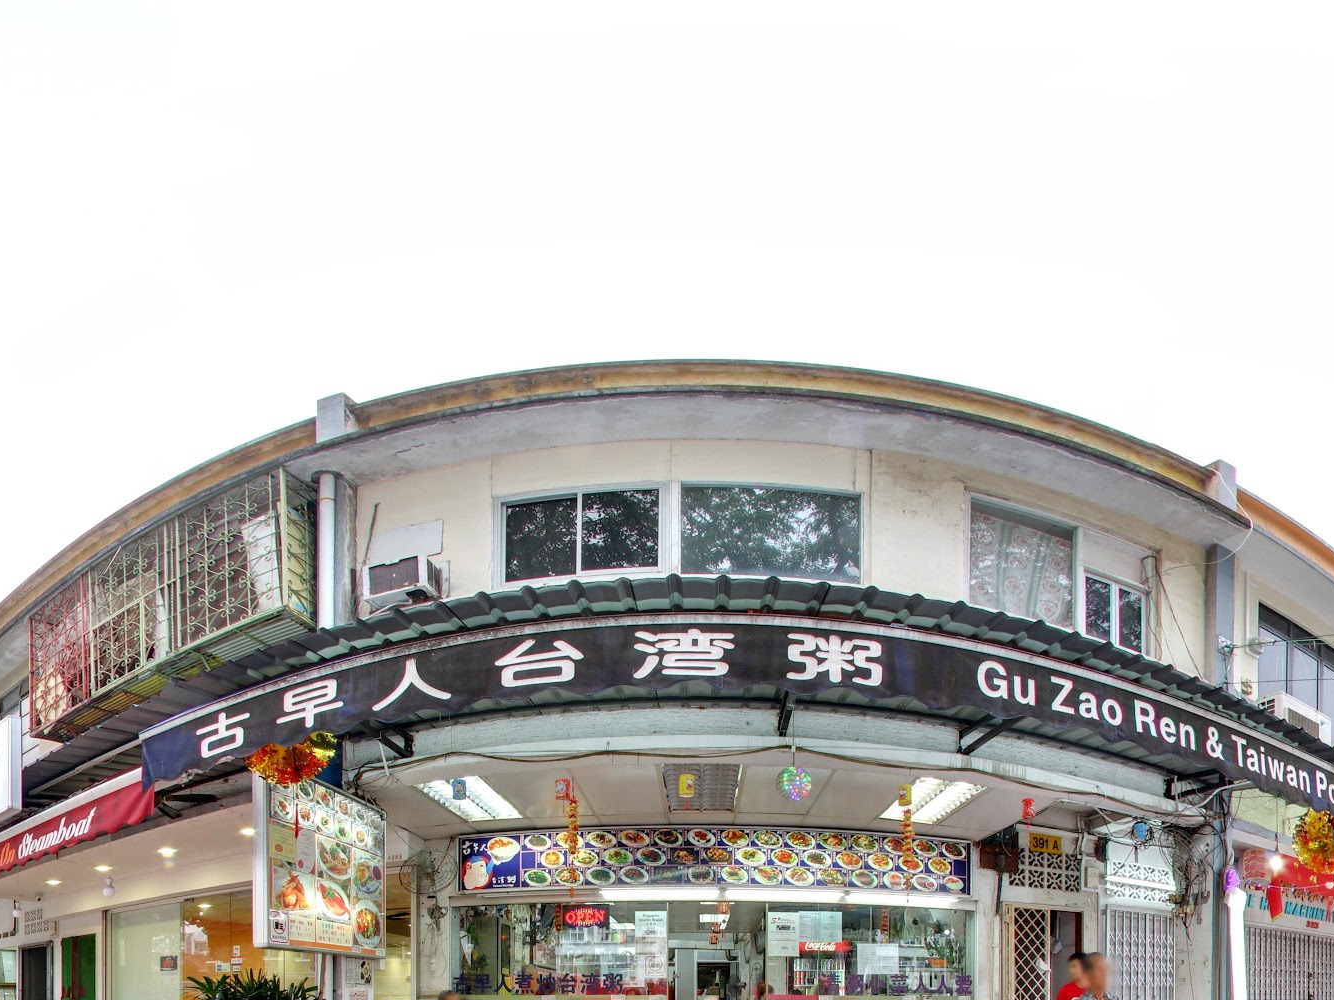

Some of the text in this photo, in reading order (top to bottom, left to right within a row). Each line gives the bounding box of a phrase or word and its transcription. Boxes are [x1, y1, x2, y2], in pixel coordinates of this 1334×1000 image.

[195, 628, 883, 759] 古早人台湾粥
[977, 659, 1036, 707] Gu
[1050, 676, 1124, 727] Zao
[1133, 698, 1199, 752] Ren
[1205, 725, 1227, 761] &
[1230, 733, 1312, 794] Taiwan
[0, 842, 16, 867] On
[17, 806, 97, 860] Steamboat
[1032, 836, 1059, 851] 391 A
[565, 911, 605, 923] OPEN
[453, 972, 624, 995] 古早人煮炒台湾粥
[819, 972, 973, 996] 清粥小菜人人爱
